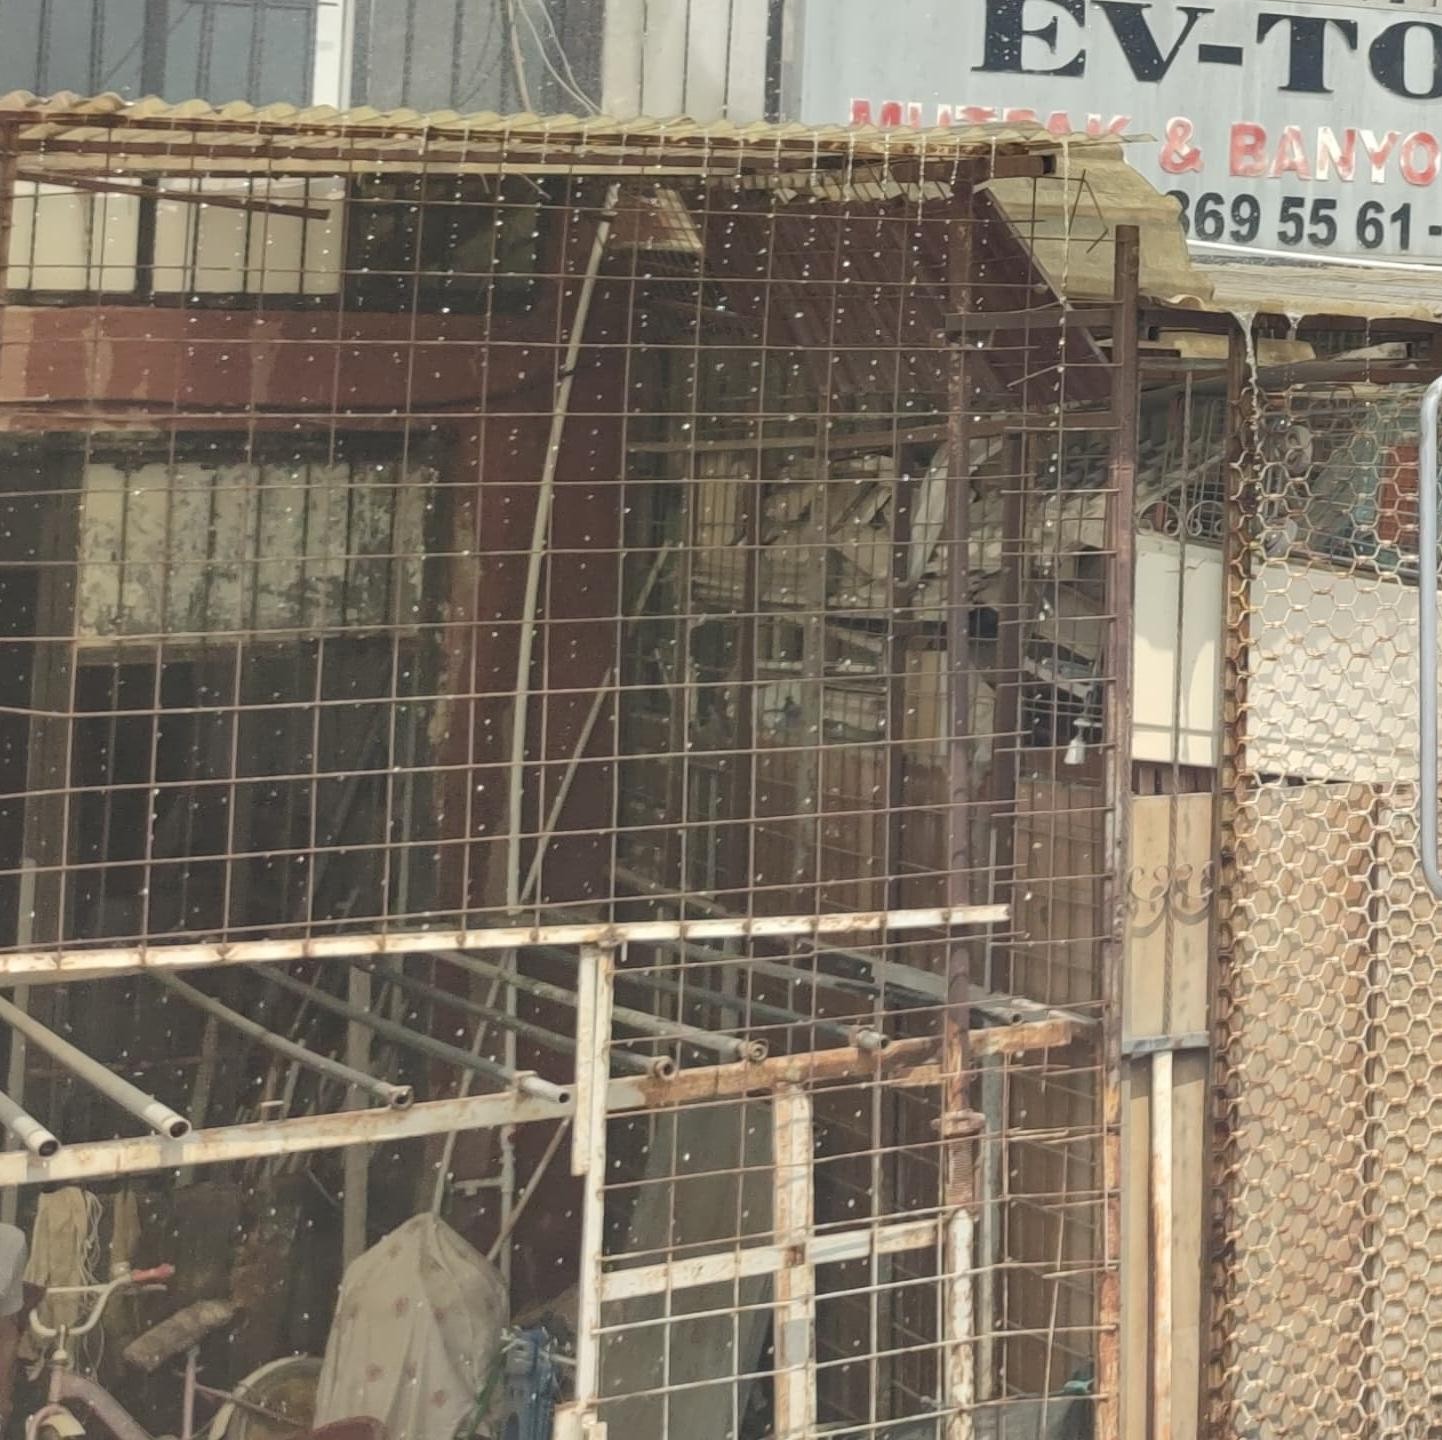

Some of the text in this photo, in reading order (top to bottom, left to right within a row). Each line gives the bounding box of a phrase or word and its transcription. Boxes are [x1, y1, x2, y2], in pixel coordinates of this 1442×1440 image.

[1159, 116, 1204, 174] &
[1229, 122, 1441, 186] BANYO
[1278, 196, 1337, 247] 55
[1356, 201, 1411, 250] 61
